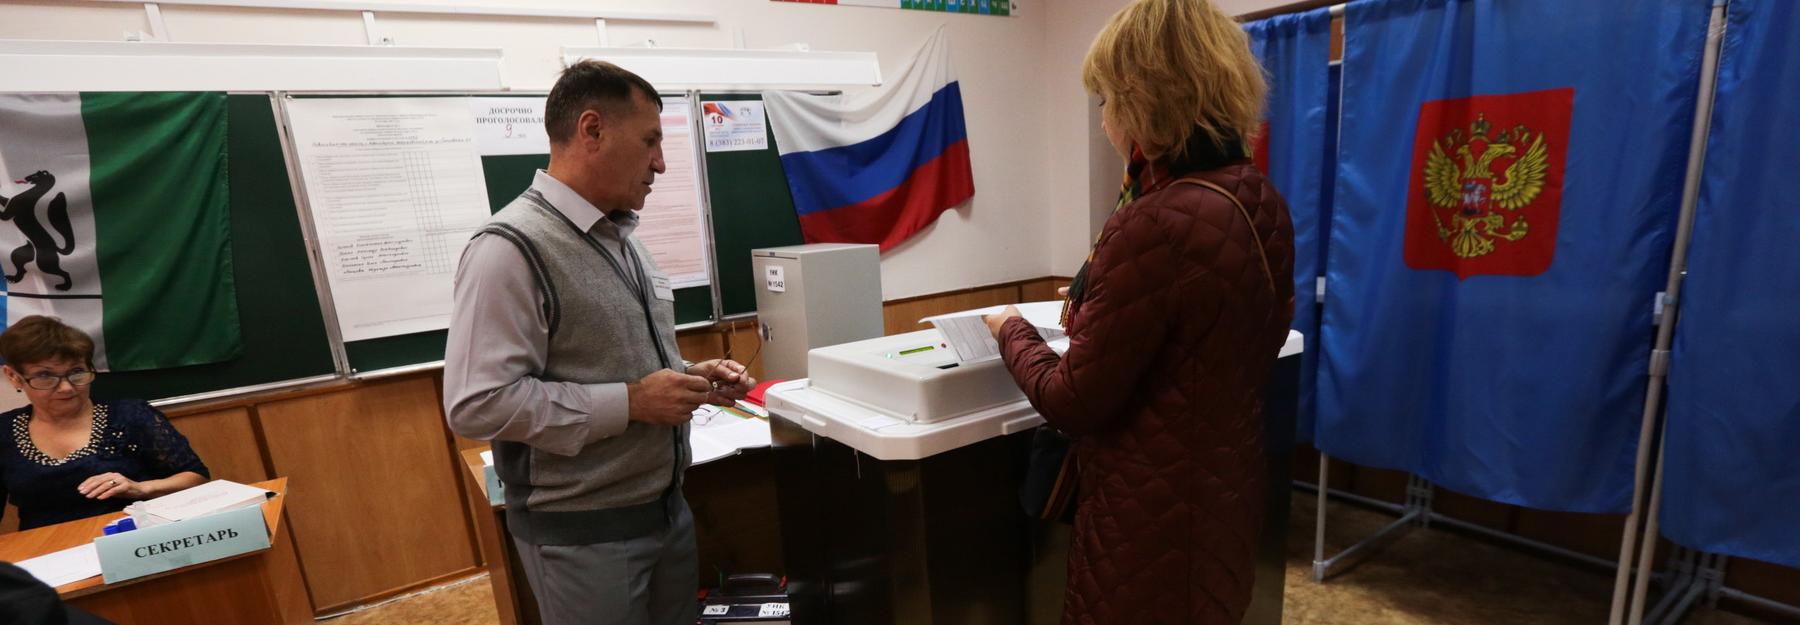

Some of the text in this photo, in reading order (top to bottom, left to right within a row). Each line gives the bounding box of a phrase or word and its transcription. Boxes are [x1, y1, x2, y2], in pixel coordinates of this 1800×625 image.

[489, 107, 534, 115] ДОСРОЧНО
[711, 115, 723, 124] 10
[504, 123, 513, 138] 9
[134, 528, 239, 558] СЕКРЕТАРЬ
